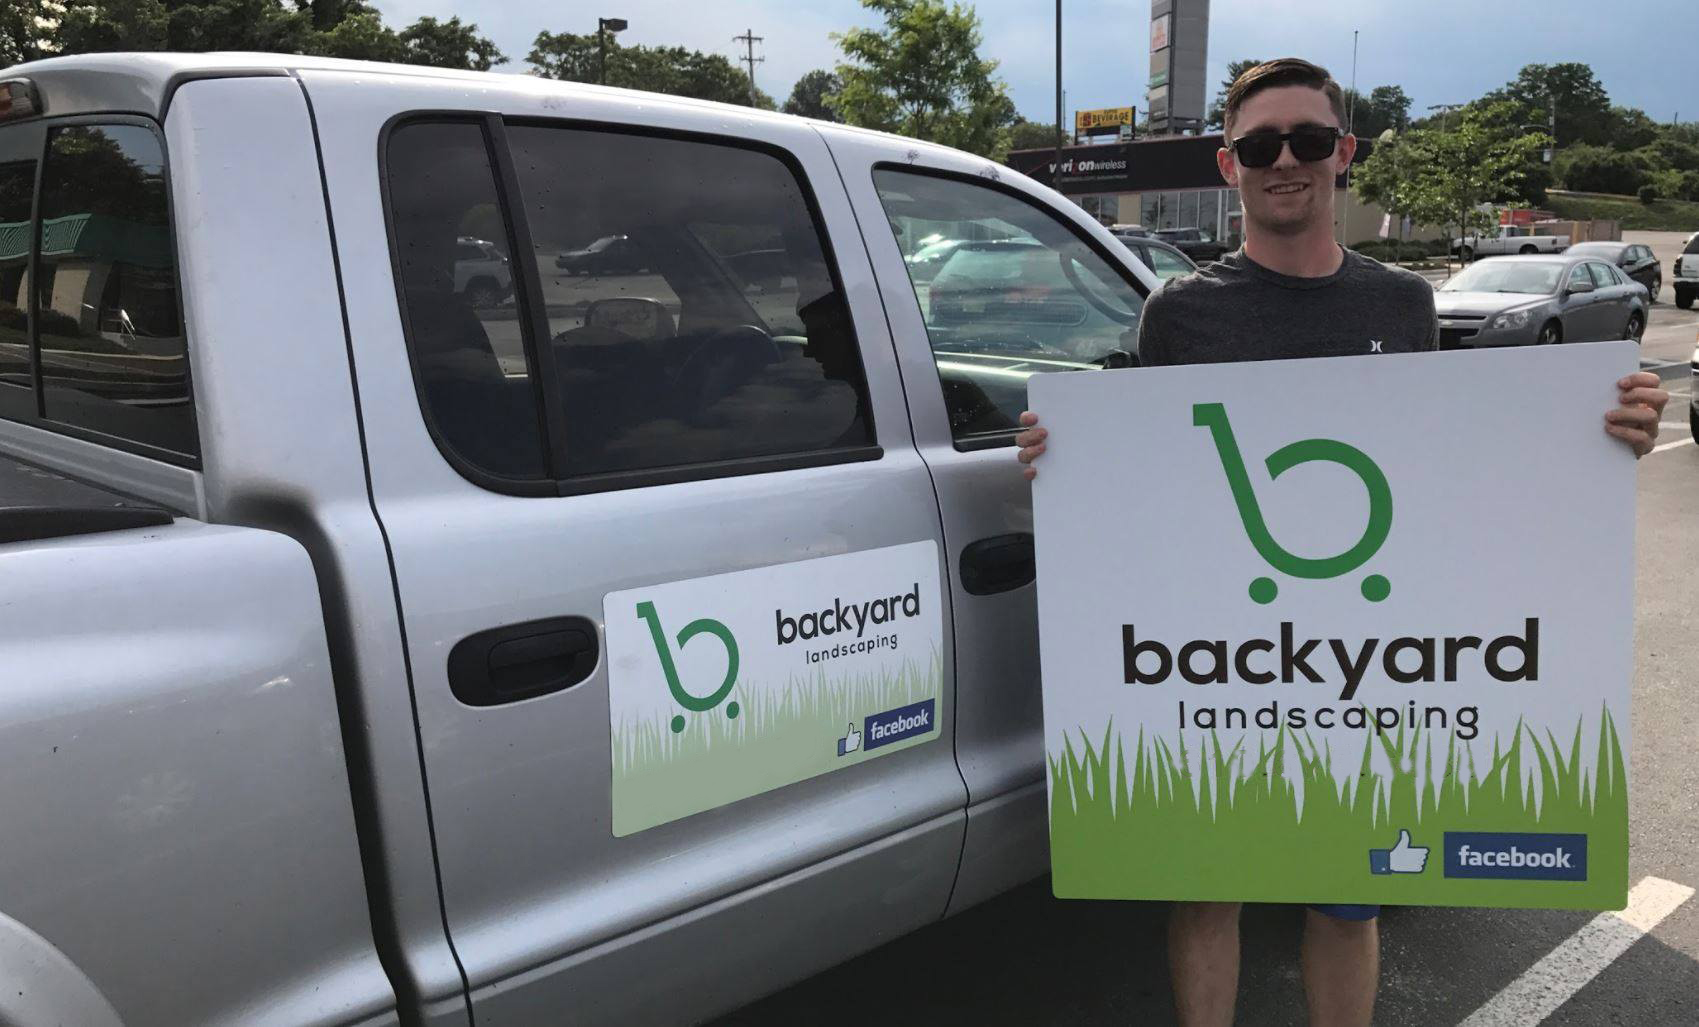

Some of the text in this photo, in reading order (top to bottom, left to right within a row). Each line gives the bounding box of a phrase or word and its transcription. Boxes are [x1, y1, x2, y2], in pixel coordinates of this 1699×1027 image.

[775, 583, 920, 646] backyard
[805, 633, 899, 665] landscaping
[1122, 617, 1540, 701] backyard
[870, 709, 929, 741] facebook
[1179, 700, 1480, 740] landscaping
[1458, 845, 1572, 869] facebook
